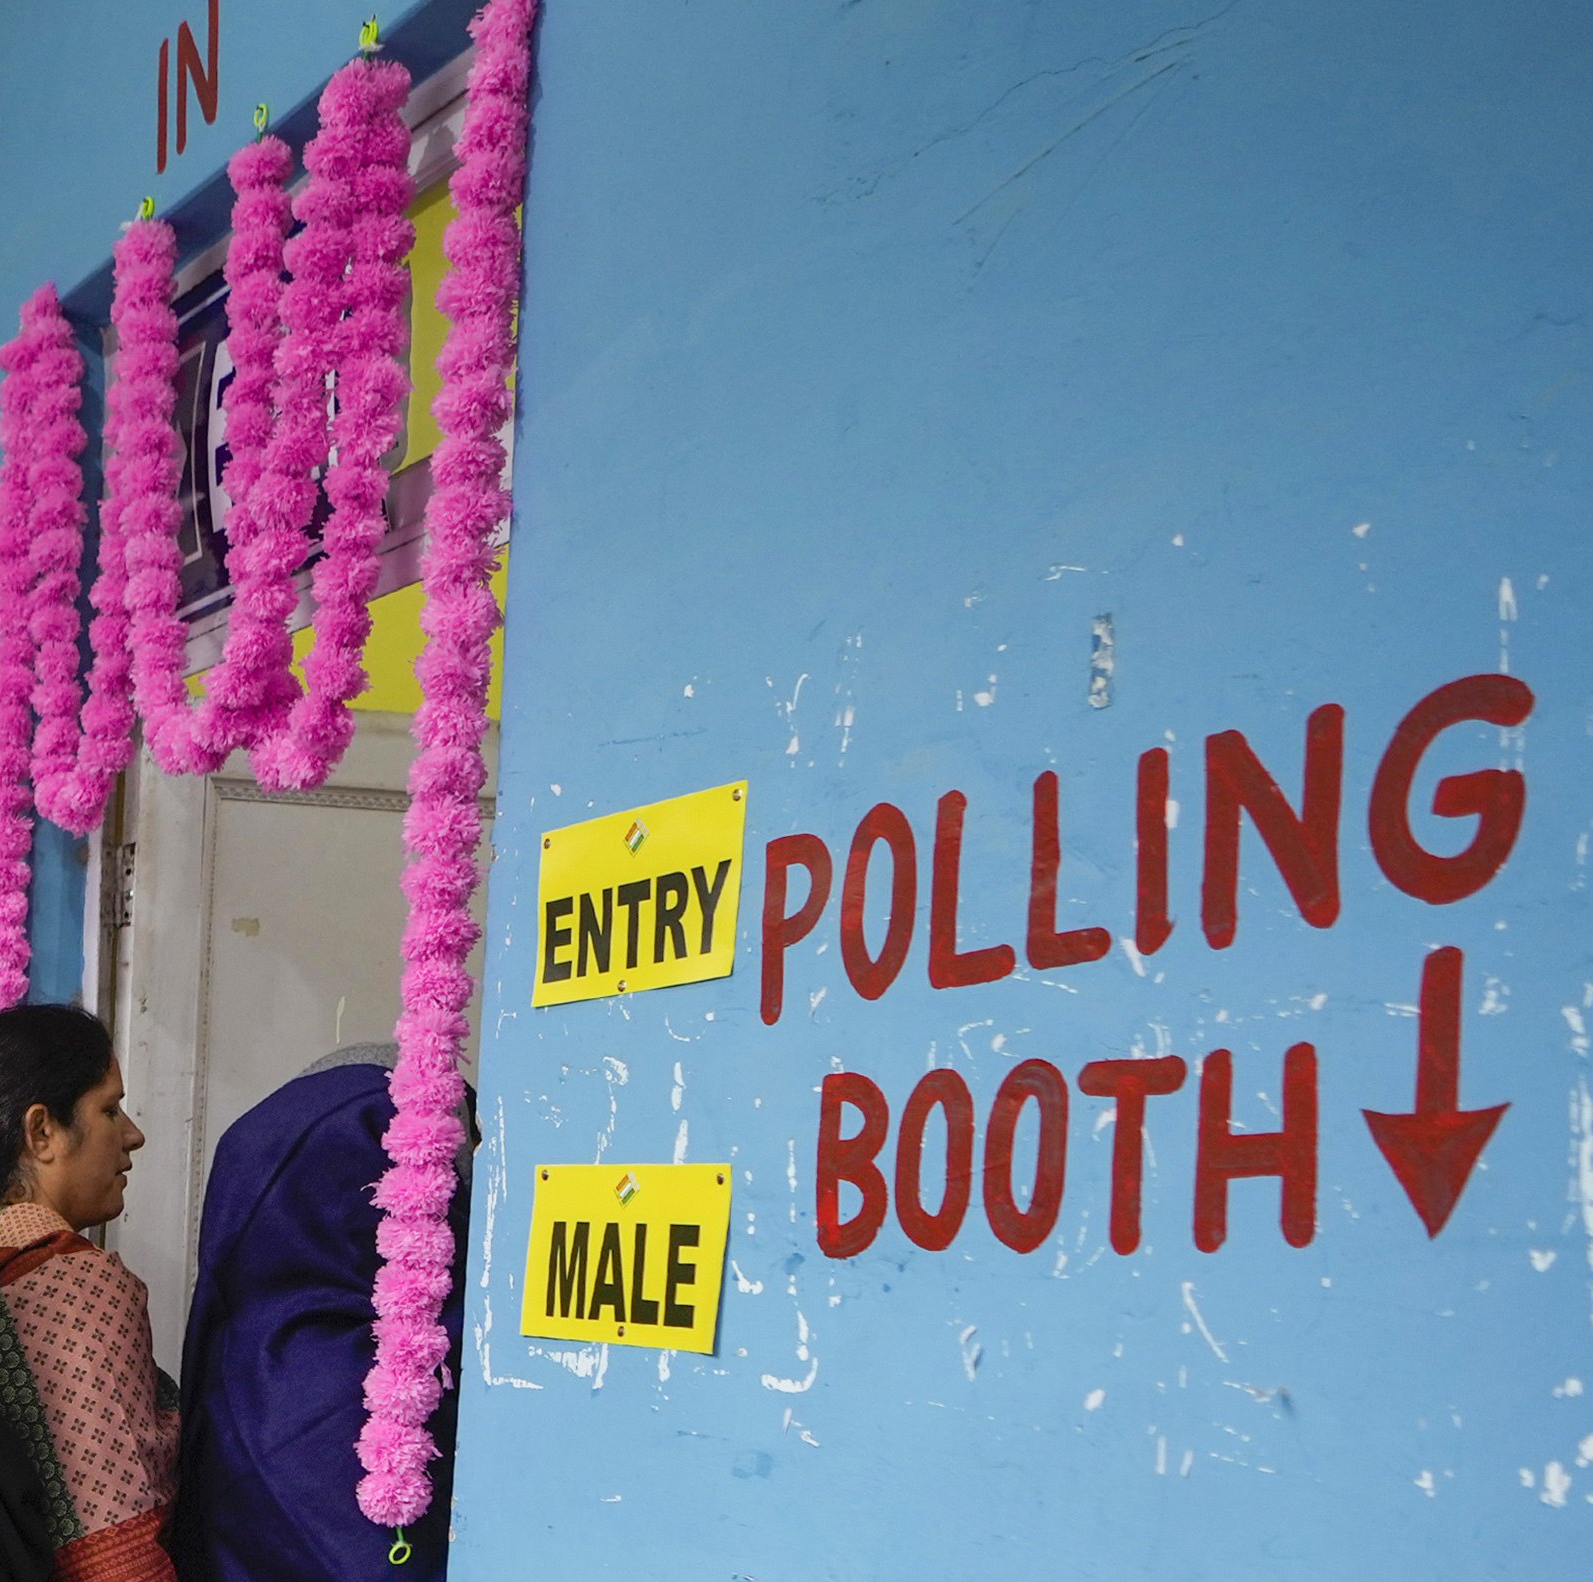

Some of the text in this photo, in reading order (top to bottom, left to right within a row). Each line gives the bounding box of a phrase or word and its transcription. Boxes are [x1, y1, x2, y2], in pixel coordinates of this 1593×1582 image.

[157, 0, 219, 174] IN
[542, 859, 732, 984] ENTRY
[760, 673, 1535, 1025] POLLING
[816, 1042, 1318, 1258] BOOTH
[545, 1221, 700, 1328] MALE
